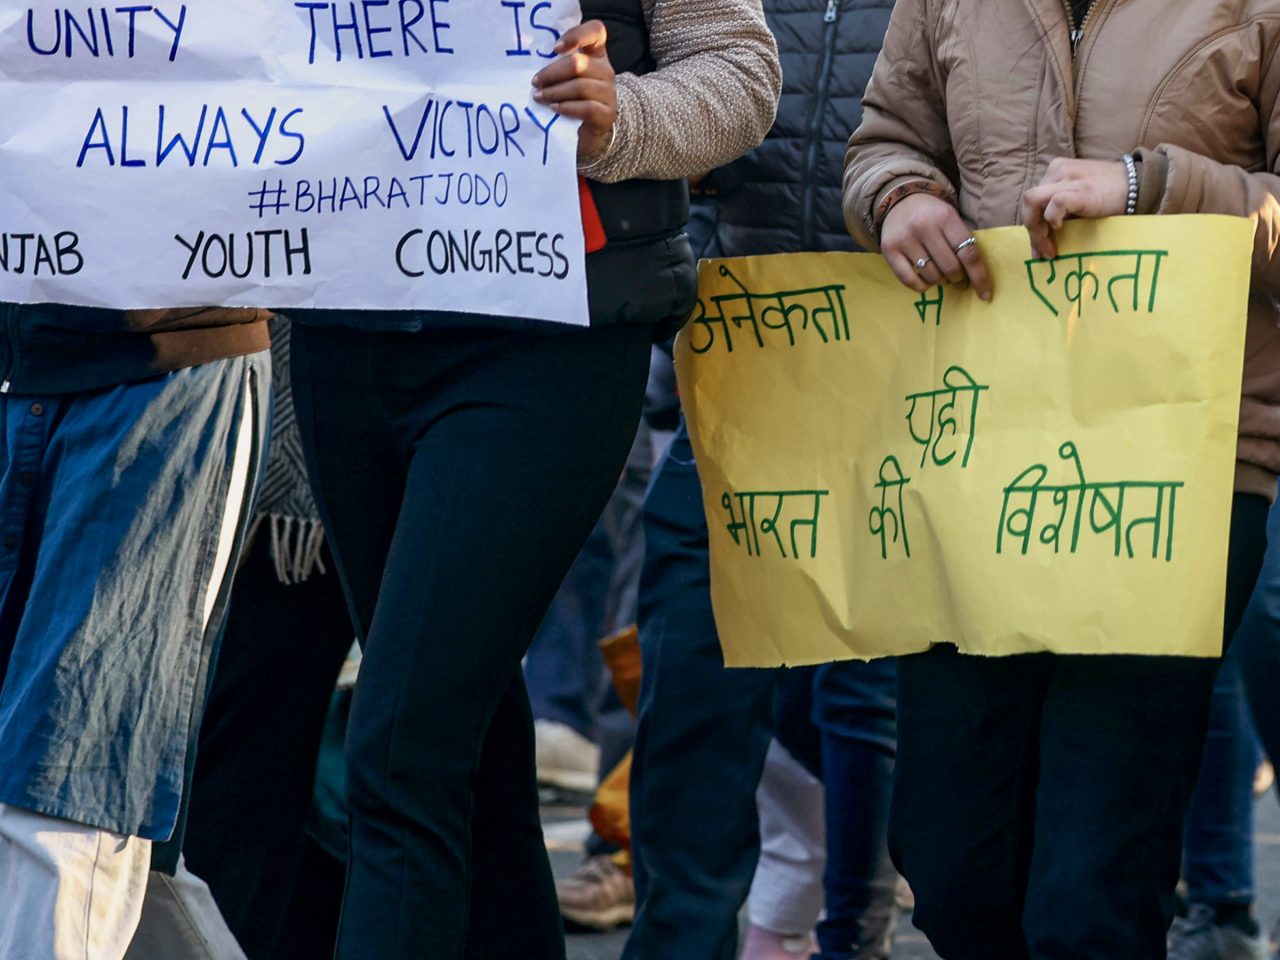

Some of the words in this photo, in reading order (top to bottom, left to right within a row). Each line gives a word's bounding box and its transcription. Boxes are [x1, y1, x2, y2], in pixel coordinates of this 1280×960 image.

[27, 4, 186, 62] UNITY
[500, 0, 561, 59] IS
[76, 104, 304, 168] ALWAYS
[382, 99, 561, 166] VICTORY
[248, 172, 508, 218] #BHARATJODO
[174, 227, 311, 280] YOUTH
[395, 228, 569, 280] CONGRESS
[690, 265, 850, 353] अनेकता
[1024, 248, 1168, 318] एकता
[905, 365, 989, 469] यही
[722, 490, 829, 559] भारत
[869, 455, 911, 559] की
[996, 441, 1184, 562] विशेषता
